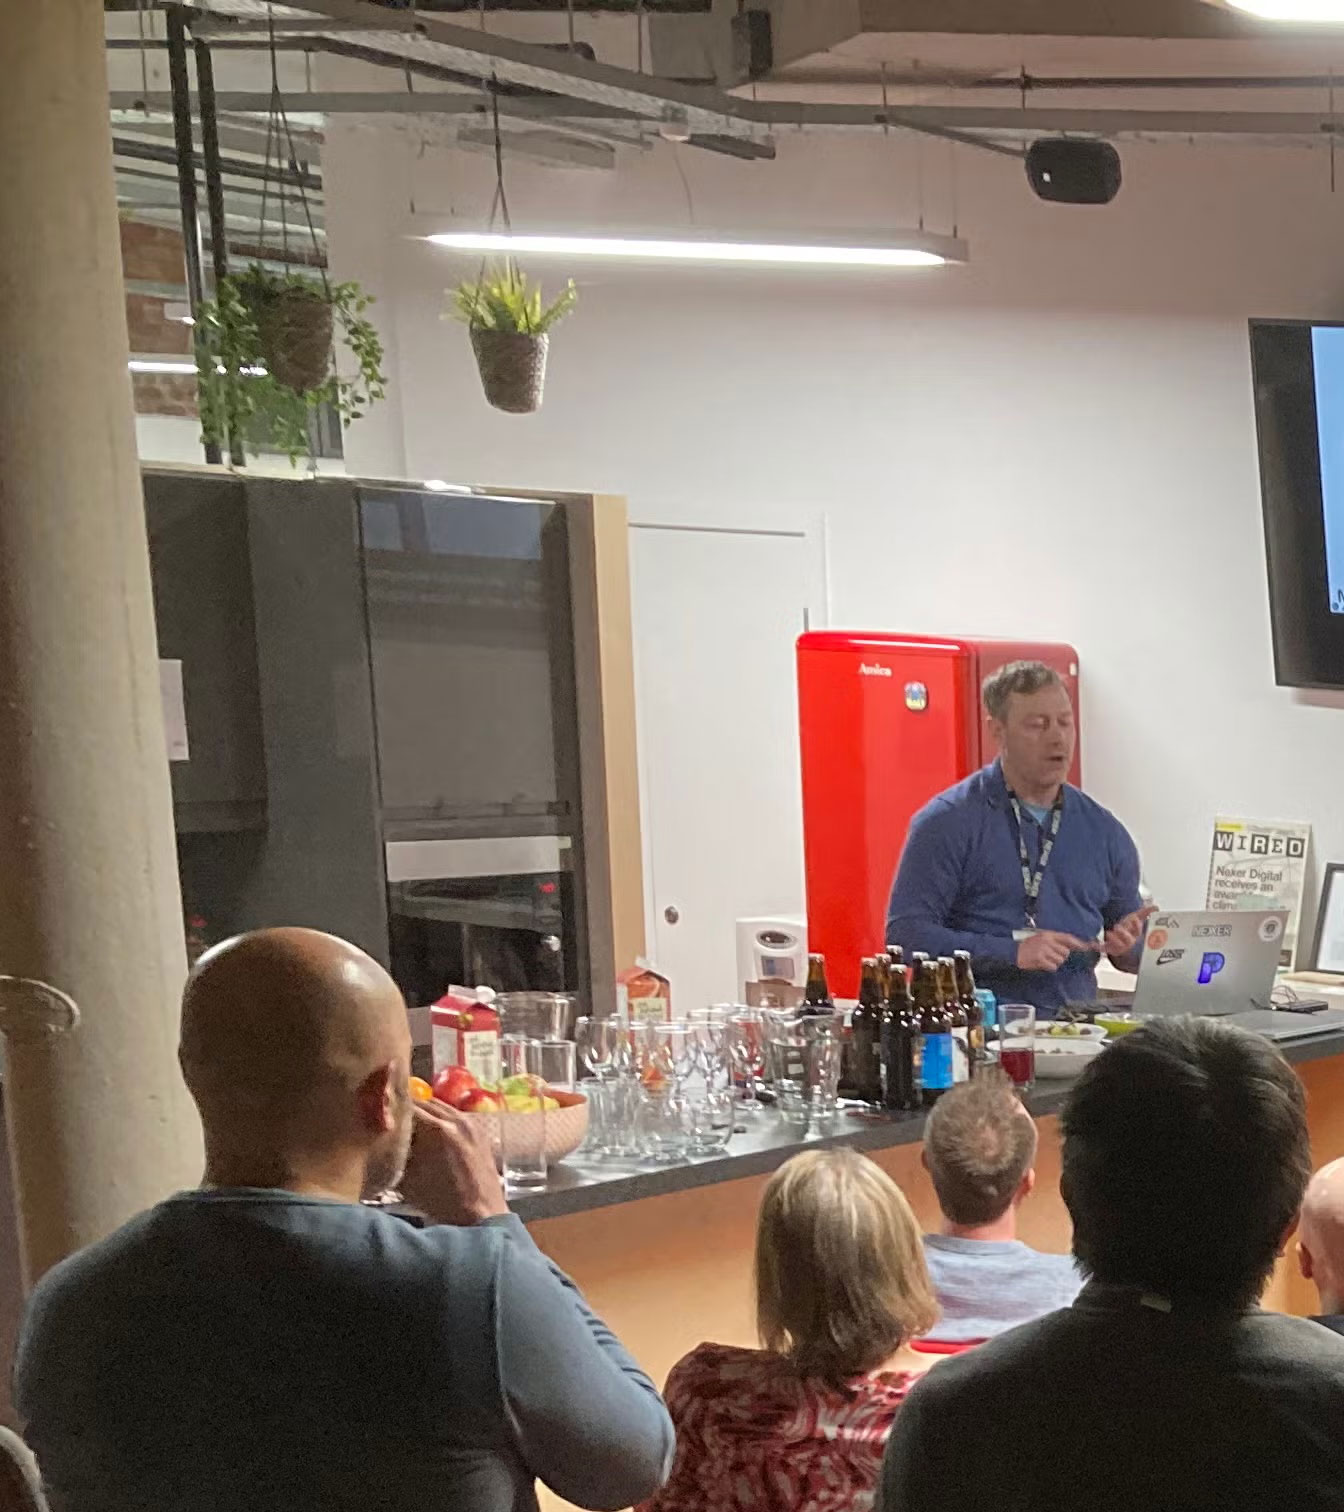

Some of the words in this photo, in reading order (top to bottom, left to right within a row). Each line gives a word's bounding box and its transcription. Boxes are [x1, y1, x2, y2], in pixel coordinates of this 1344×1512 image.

[1213, 831, 1305, 858] WIRED
[1216, 865, 1247, 878] Nexer
[1249, 868, 1283, 882] Digital
[1215, 879, 1258, 891] receives
[1260, 883, 1274, 892] an
